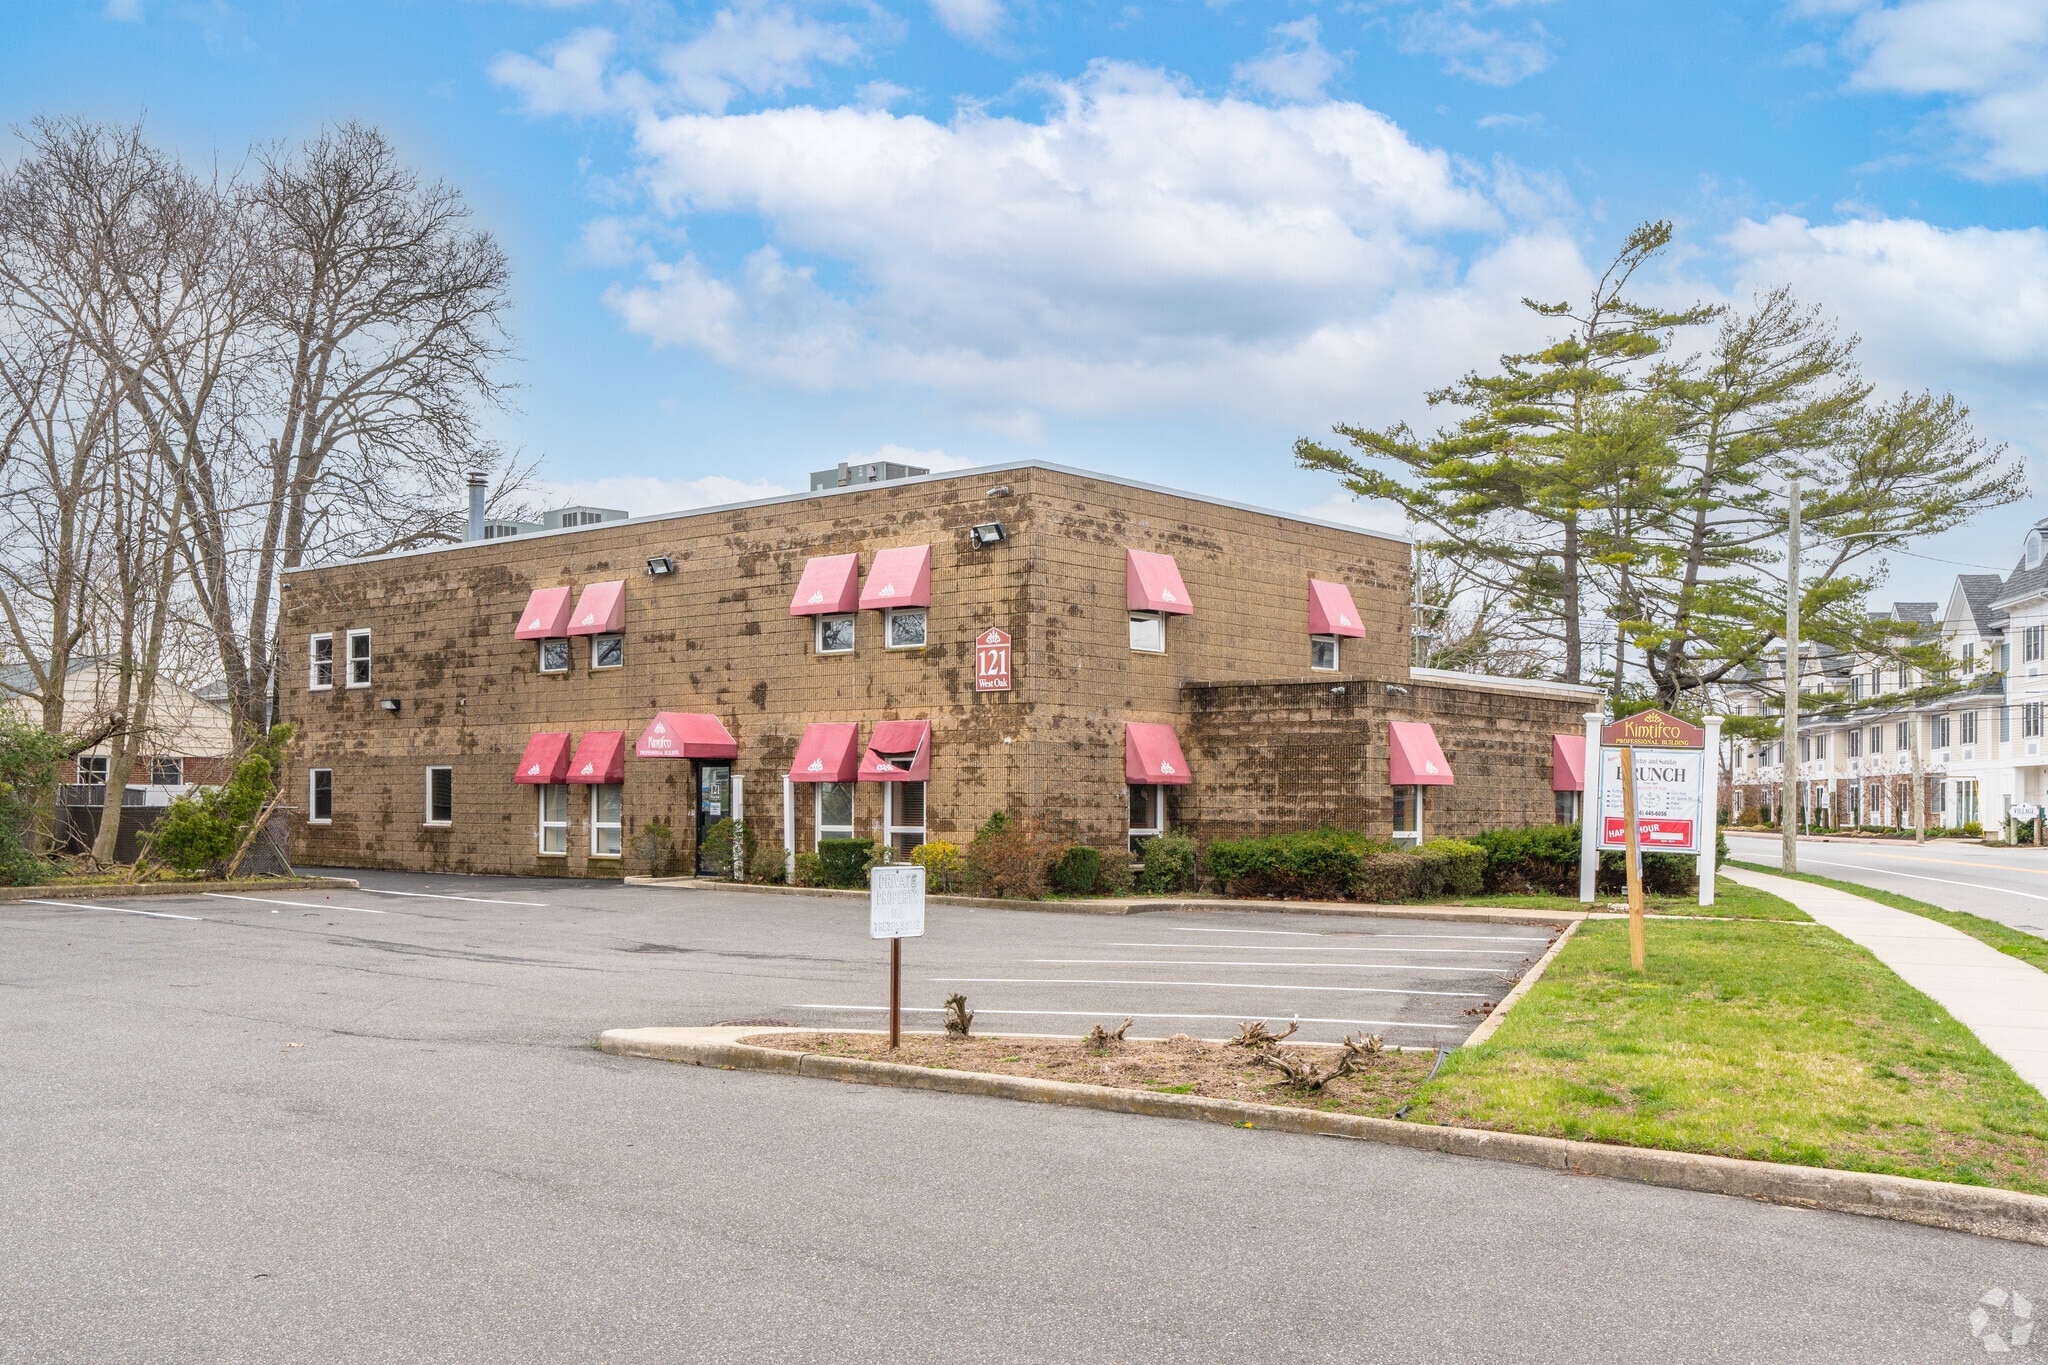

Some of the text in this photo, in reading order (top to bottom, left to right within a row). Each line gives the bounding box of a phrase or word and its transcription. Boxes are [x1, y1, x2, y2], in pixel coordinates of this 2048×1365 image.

[979, 649, 1008, 676] 121
[979, 678, 1008, 688] West Oak
[1624, 721, 1681, 739] Kimtifco
[1616, 766, 1686, 783] BUNCH
[711, 785, 720, 794] 121
[1608, 829, 1625, 838] HAP
[878, 874, 918, 889] PRIVATE
[876, 890, 919, 905] PROPERTY
